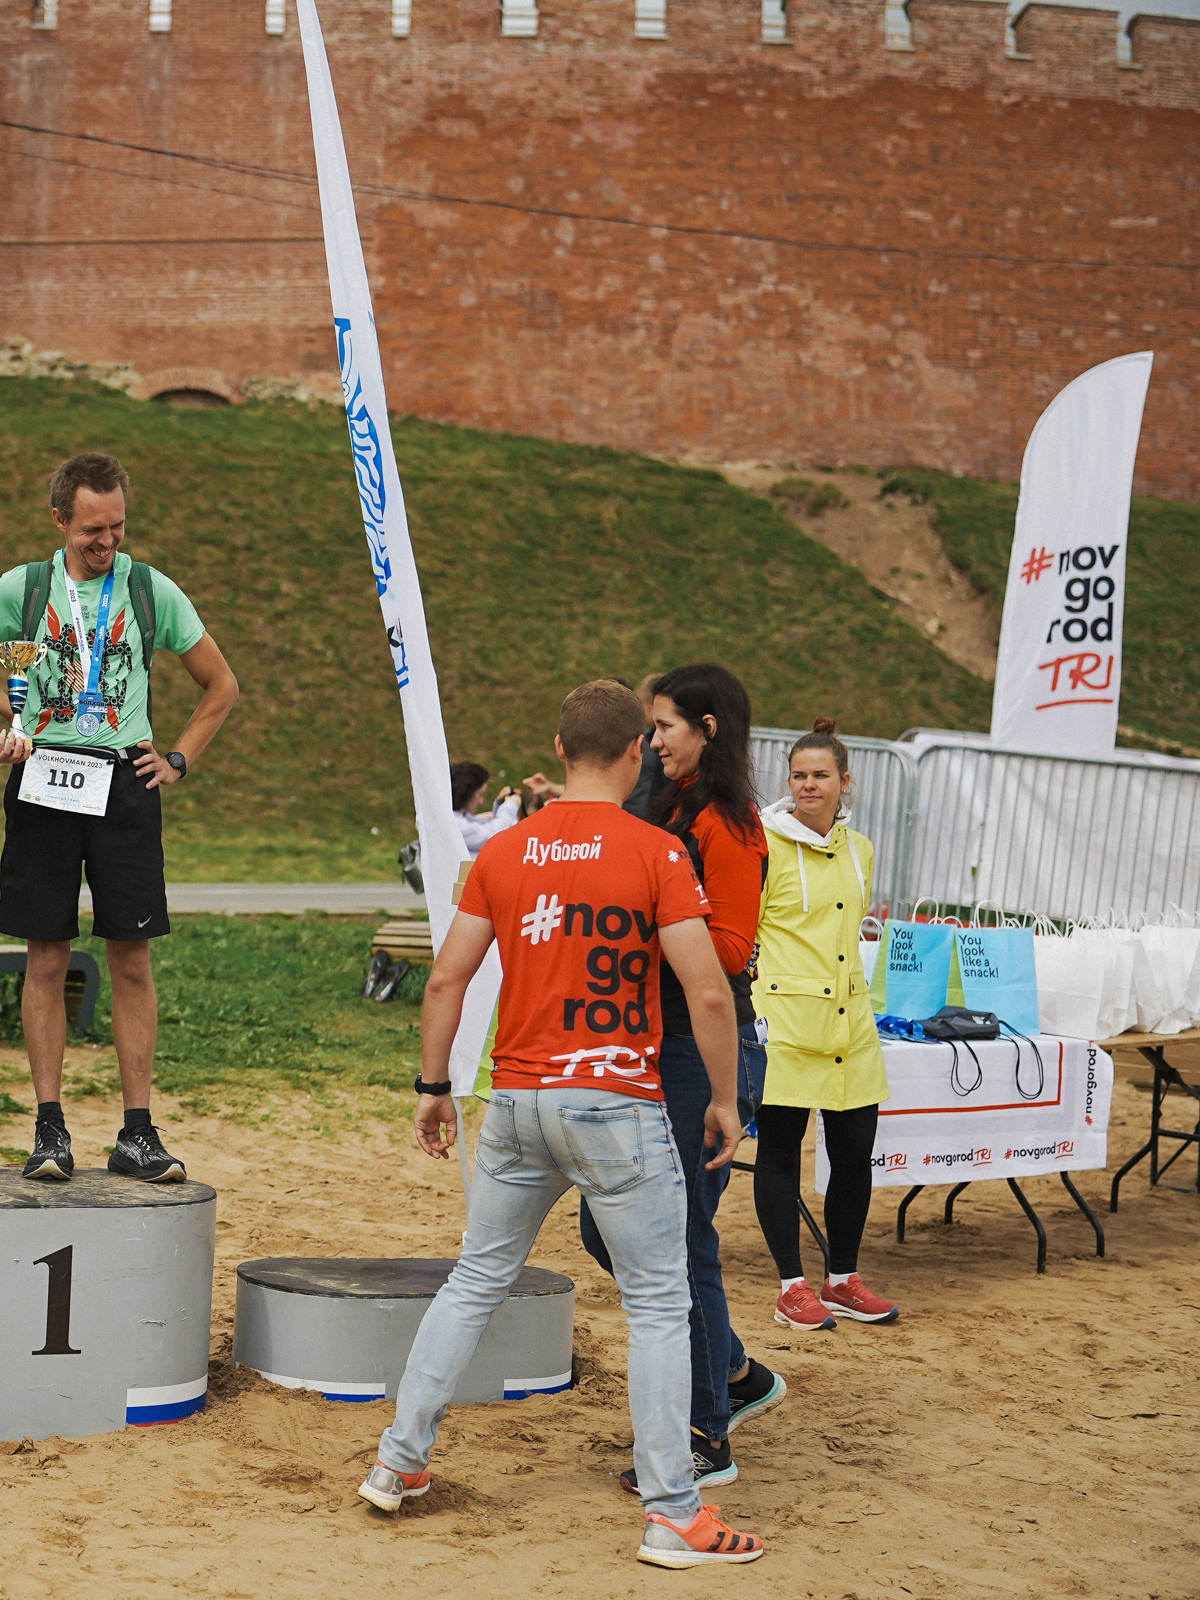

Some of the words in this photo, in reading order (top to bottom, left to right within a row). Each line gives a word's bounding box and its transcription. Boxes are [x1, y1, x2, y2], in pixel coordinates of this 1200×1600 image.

[1021, 545, 1120, 585] #nov
[1064, 576, 1115, 613] go
[1046, 602, 1114, 643] rod
[1038, 653, 1114, 691] TRI
[38, 754, 86, 766] VOLKHOVMAN
[87, 761, 103, 769] 2023
[47, 769, 85, 789] 110
[523, 835, 603, 866] Дубовой
[520, 894, 658, 945] #nov
[893, 928, 914, 940] You
[958, 935, 982, 945] You
[891, 939, 914, 950] look
[960, 946, 985, 956] look
[890, 950, 909, 961] like
[910, 953, 917, 961] a
[962, 957, 982, 967] like
[984, 959, 990, 967] a
[586, 945, 650, 995] go
[889, 962, 923, 973] snack!
[964, 967, 999, 978] snack!
[563, 981, 649, 1035] rod
[32, 1245, 81, 1355] 1
